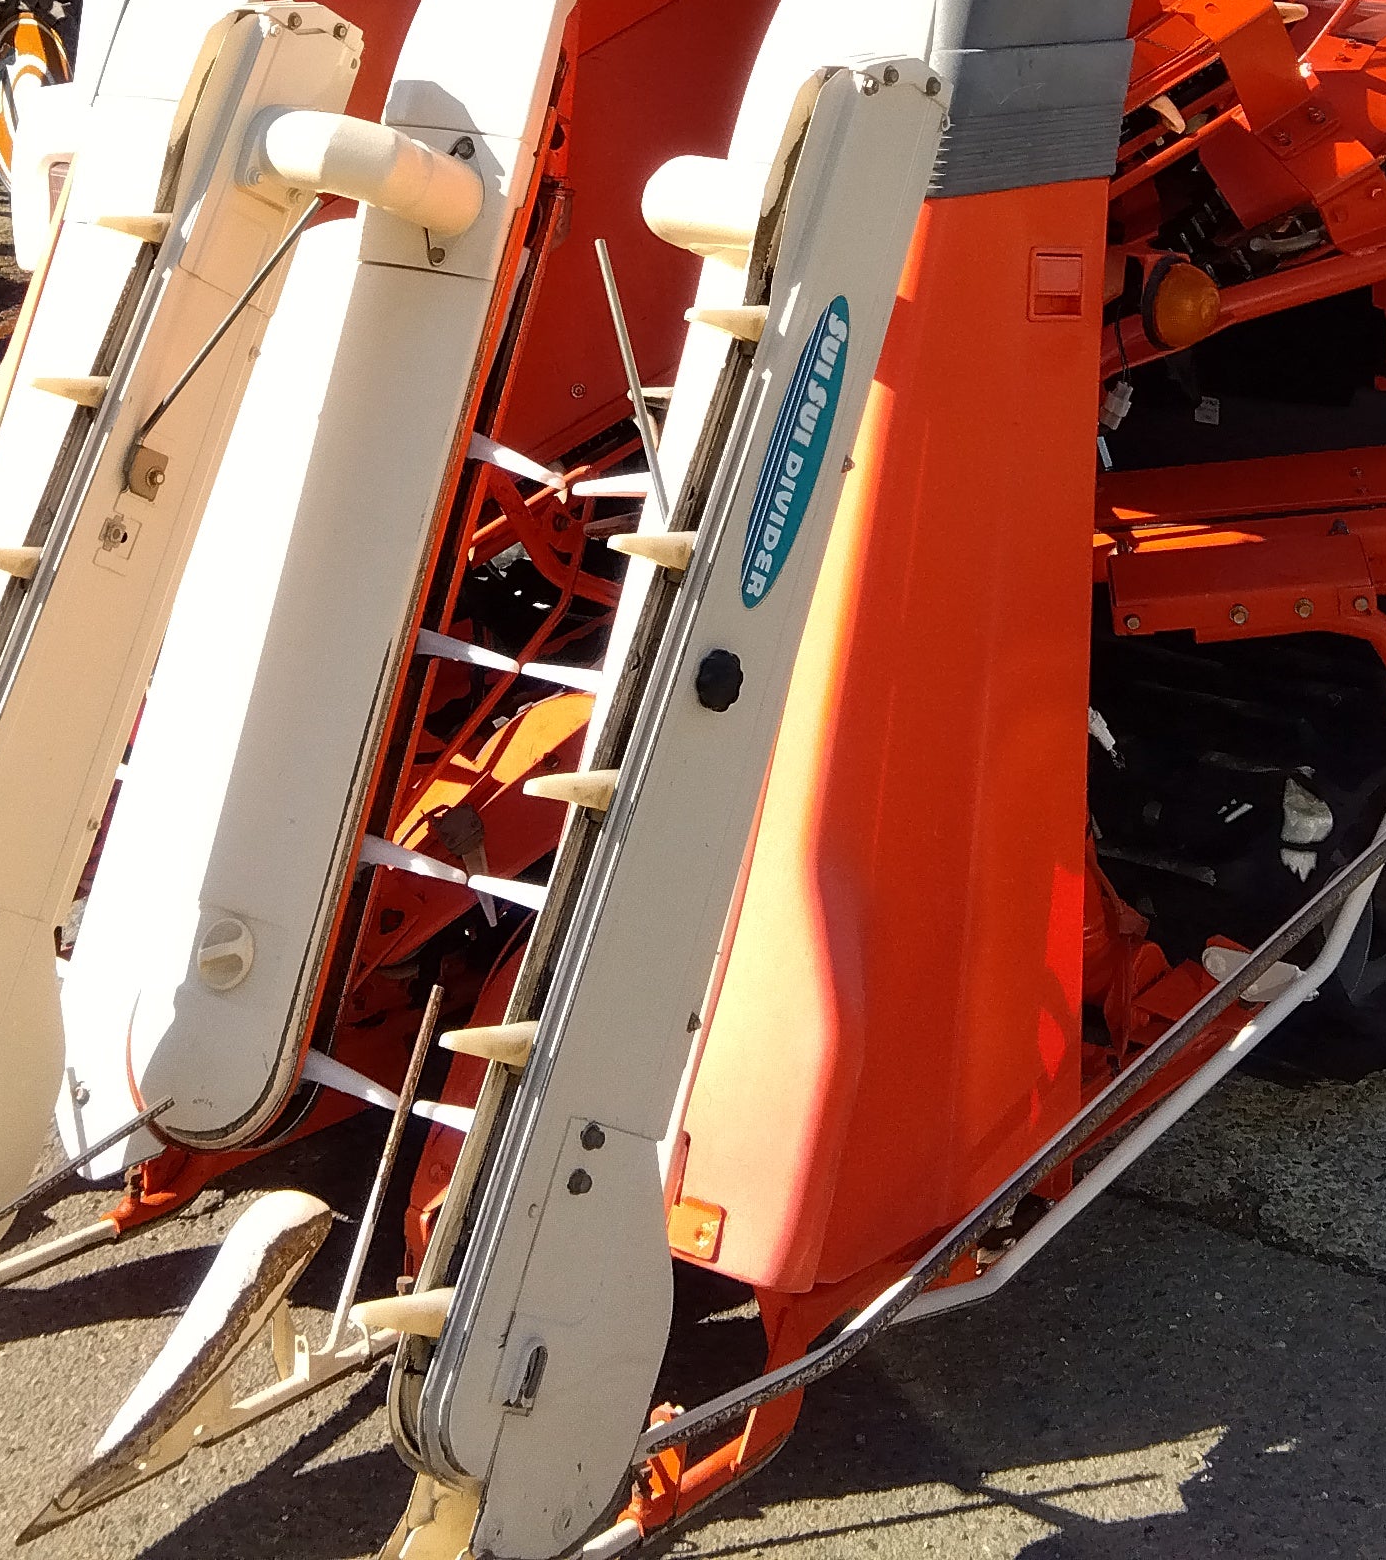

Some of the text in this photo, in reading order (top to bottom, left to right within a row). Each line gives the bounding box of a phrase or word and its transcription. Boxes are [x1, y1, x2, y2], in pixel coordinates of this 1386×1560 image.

[746, 313, 848, 598] SUI SUI DIVIDER
